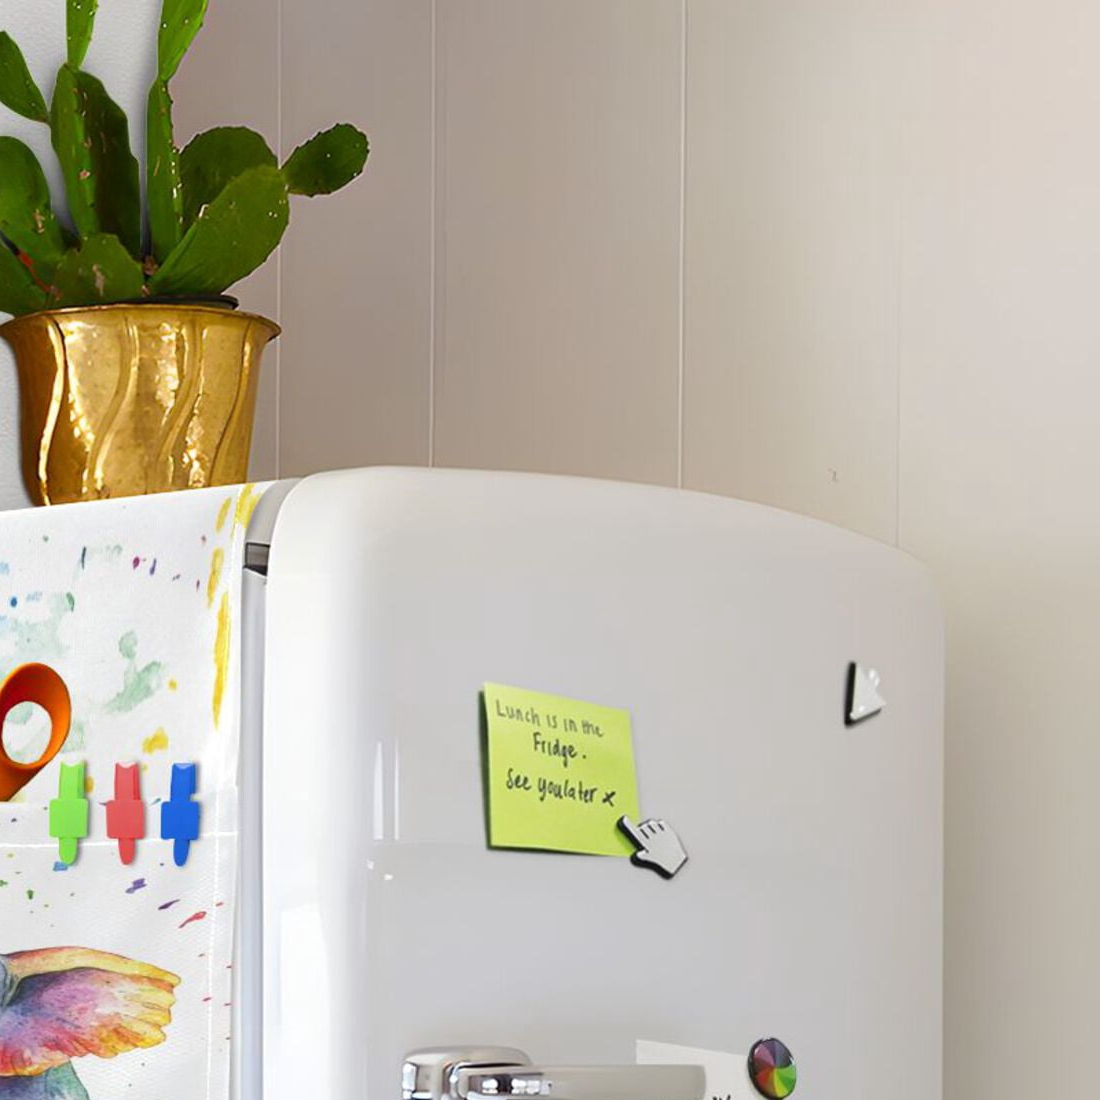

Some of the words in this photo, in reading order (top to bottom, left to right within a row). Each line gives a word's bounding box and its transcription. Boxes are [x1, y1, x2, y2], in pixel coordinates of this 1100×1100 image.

[495, 698, 540, 727] Lunch
[546, 714, 558, 729] is
[563, 718, 578, 732] in
[581, 719, 604, 737] the
[506, 767, 532, 789] See
